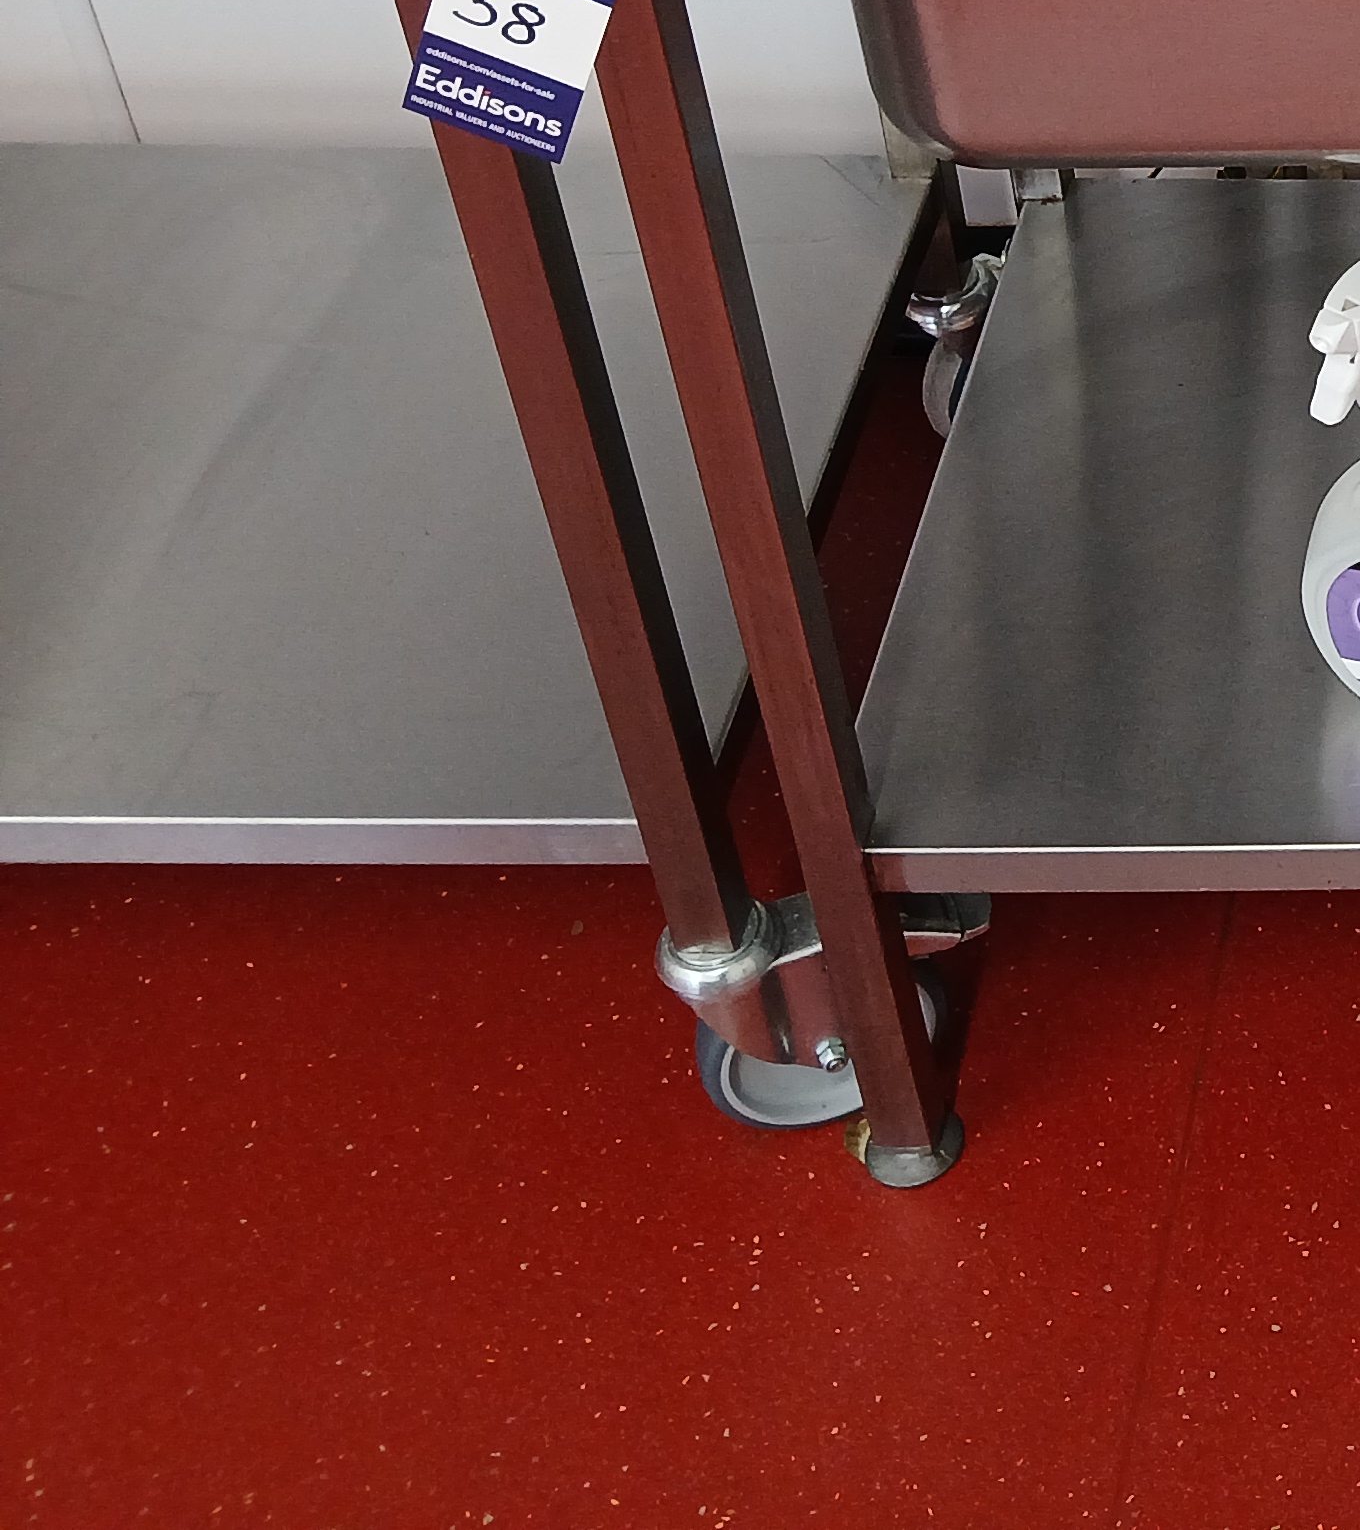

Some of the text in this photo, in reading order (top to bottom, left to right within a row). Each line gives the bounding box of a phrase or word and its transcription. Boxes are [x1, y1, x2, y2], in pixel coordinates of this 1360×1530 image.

[415, 63, 562, 138] Eddisons
[425, 47, 556, 101] eddisons.com/assets-for-sale
[410, 94, 556, 154] INDUSTRIAL VALUERS AND AUCTIONEERS
